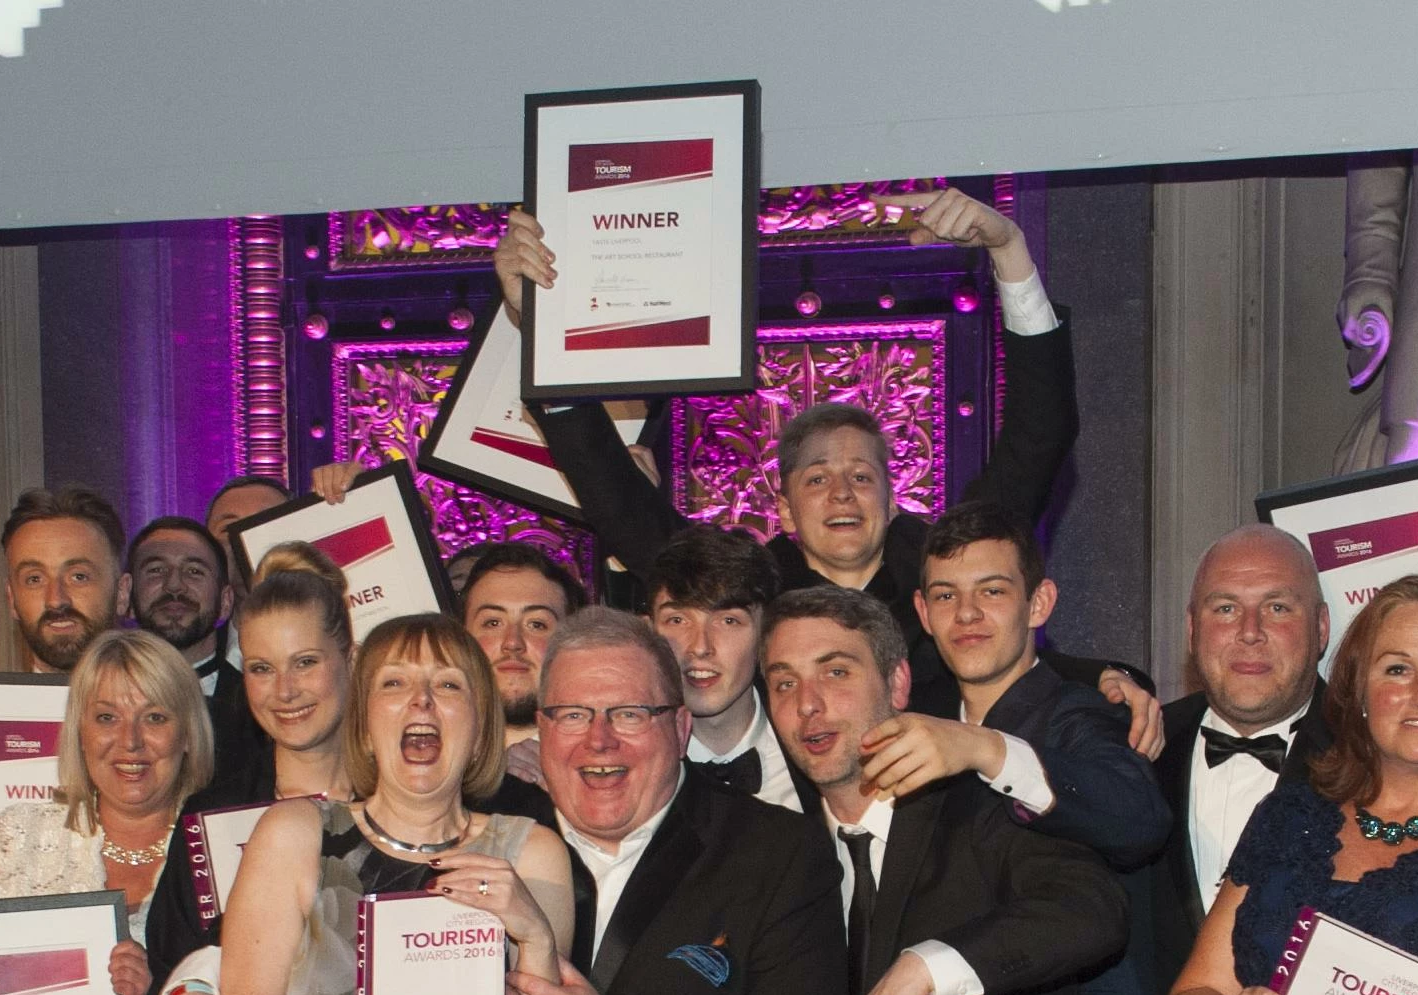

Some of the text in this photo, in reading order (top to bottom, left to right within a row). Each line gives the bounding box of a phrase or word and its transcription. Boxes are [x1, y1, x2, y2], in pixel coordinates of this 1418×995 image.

[595, 165, 631, 174] TOURISM
[593, 212, 679, 230] WINNER
[1335, 541, 1373, 553] TOURISM
[349, 586, 384, 608] NER
[187, 825, 208, 878] 2016
[452, 911, 490, 920] LIVERPOO
[446, 920, 463, 928] CITY
[401, 928, 495, 949] TOURISM
[404, 947, 495, 963] AWARDS 2016
[1278, 918, 1312, 976] 2016
[1382, 978, 1400, 990] CITY
